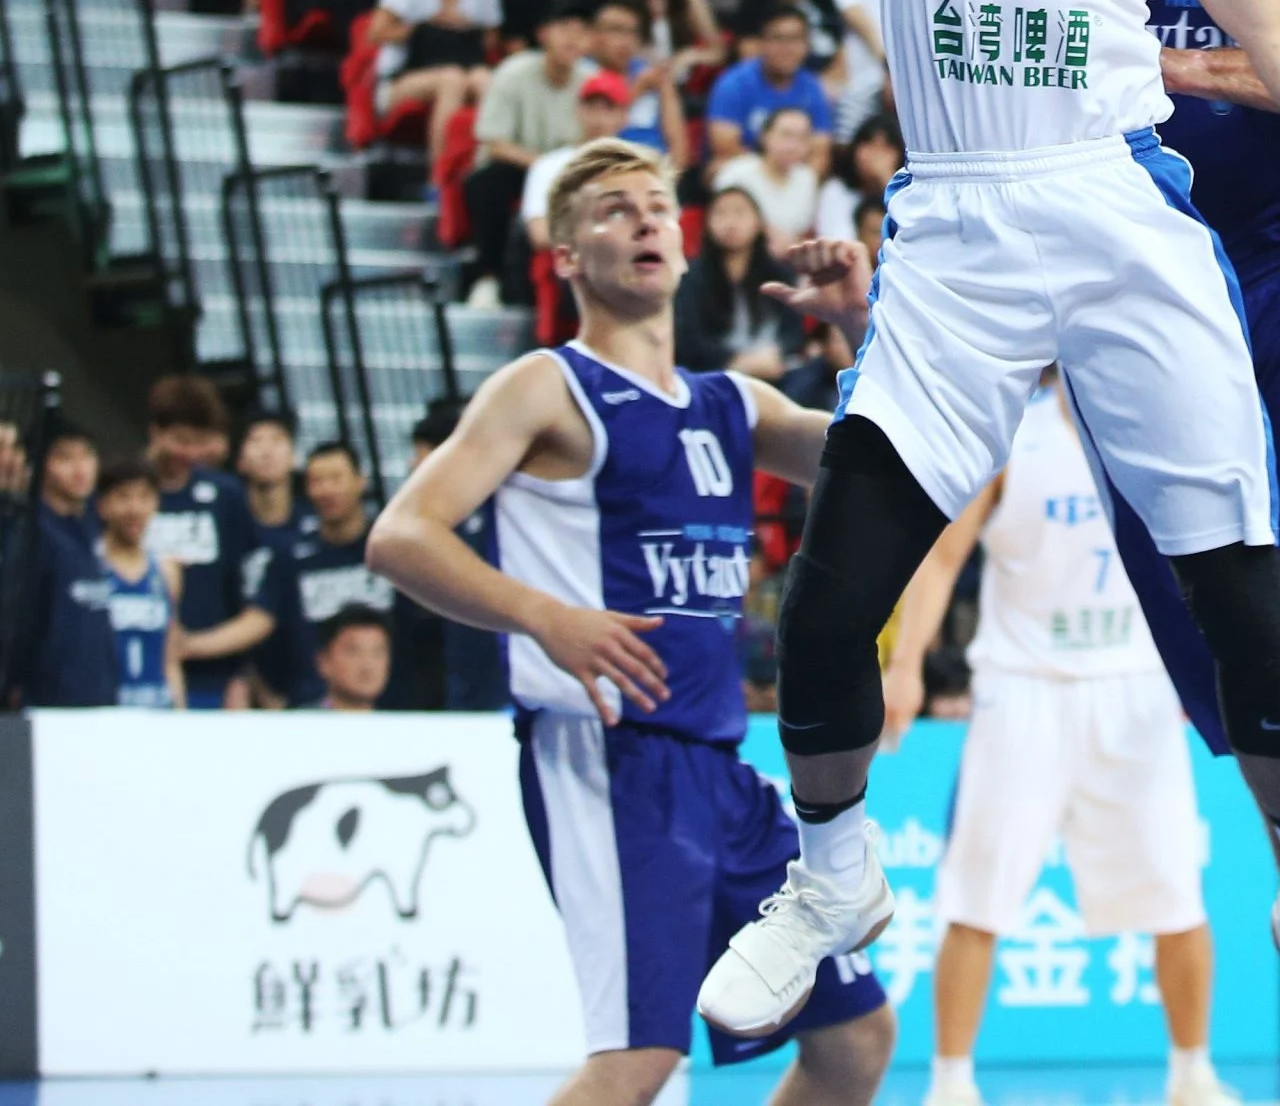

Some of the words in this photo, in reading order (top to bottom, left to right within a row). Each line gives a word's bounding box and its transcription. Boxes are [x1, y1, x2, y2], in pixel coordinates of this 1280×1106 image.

[933, 58, 1024, 87] TAIWAN
[1024, 66, 1089, 90] BEER
[677, 428, 734, 498] 10
[1090, 548, 1112, 594] 7
